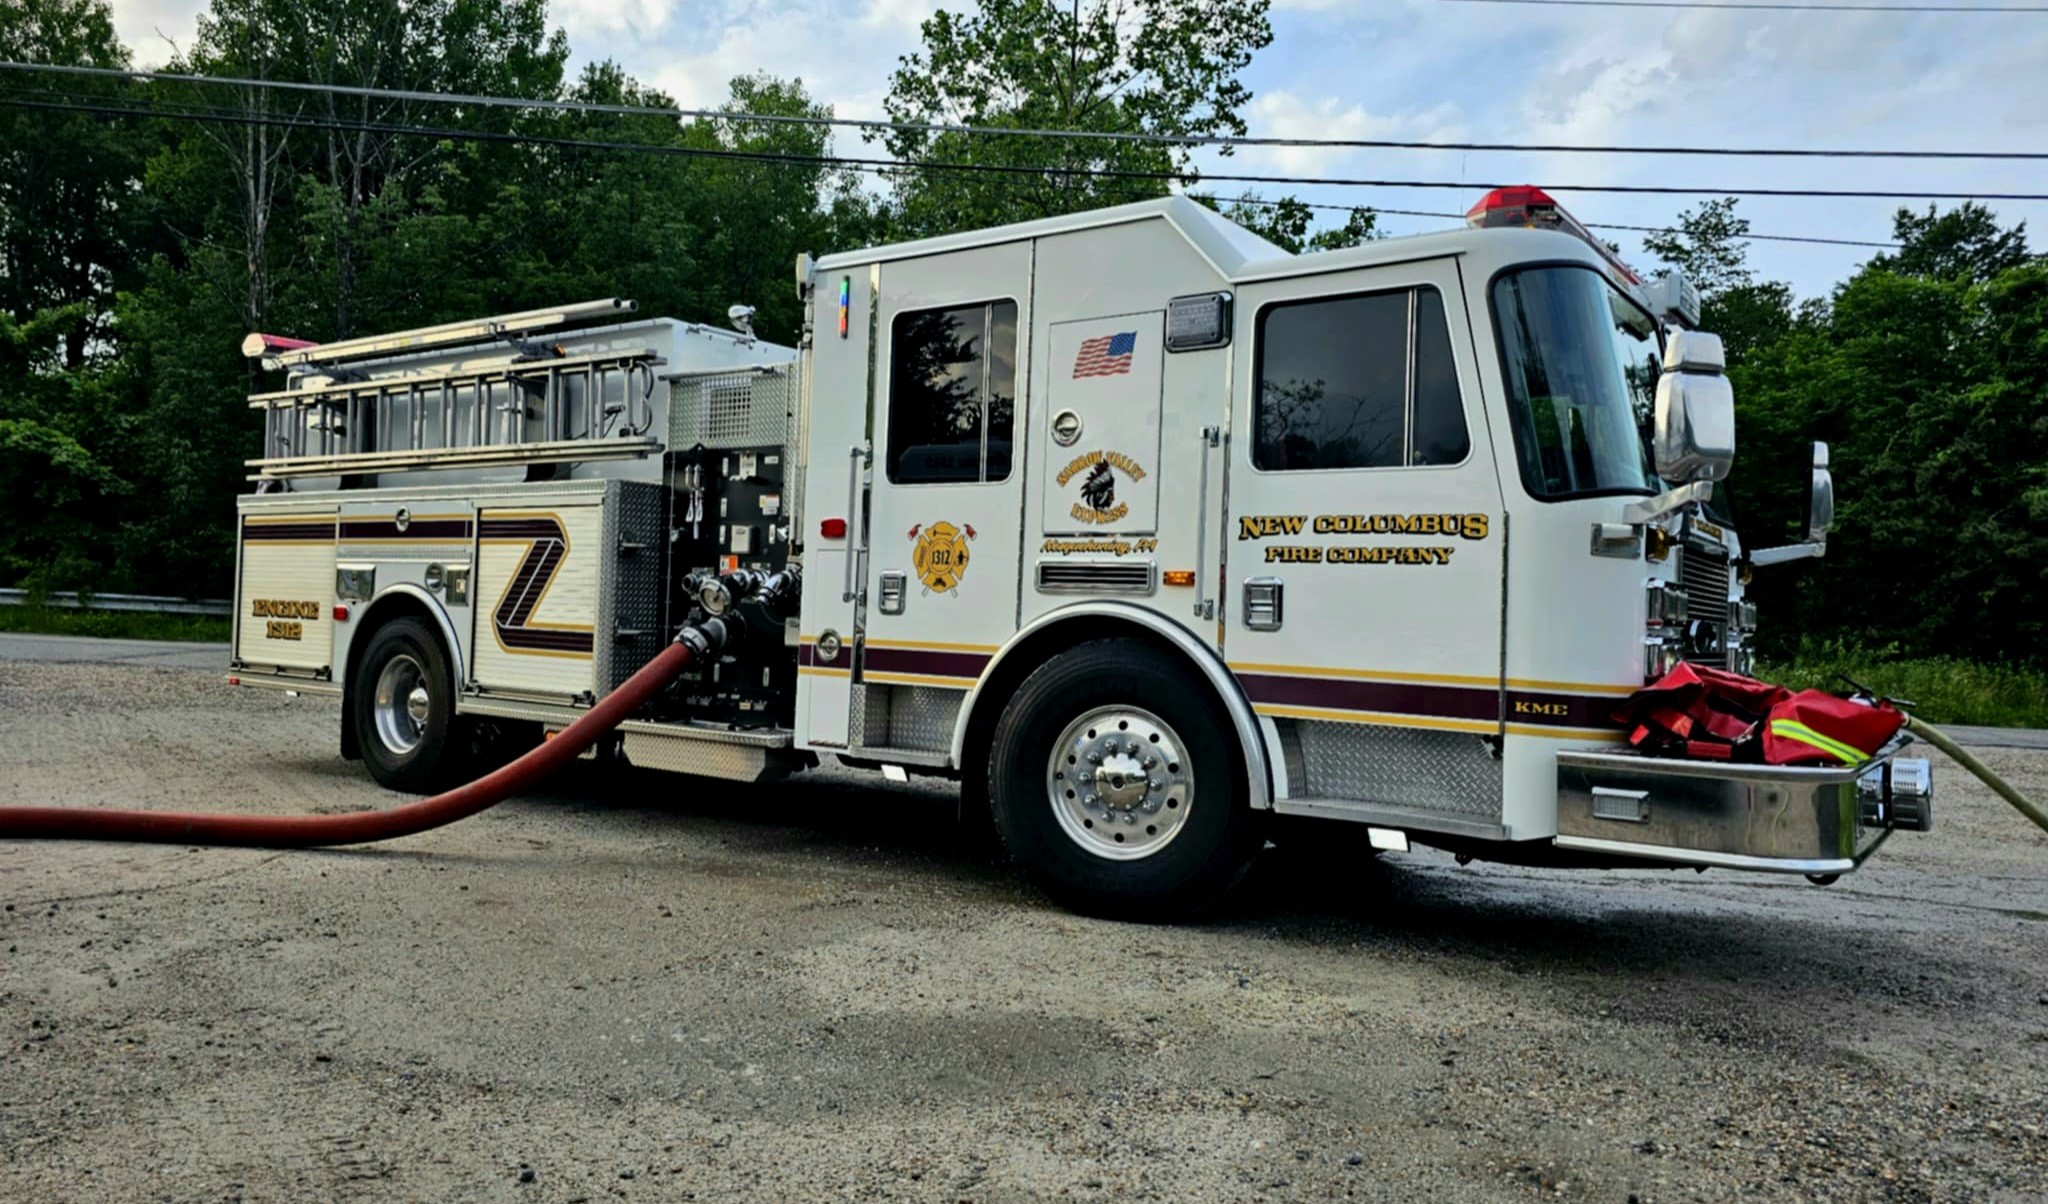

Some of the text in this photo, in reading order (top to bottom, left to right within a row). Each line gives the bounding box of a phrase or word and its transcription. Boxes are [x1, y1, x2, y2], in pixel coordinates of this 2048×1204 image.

[1106, 451, 1146, 482] VALLEY
[1070, 502, 1129, 525] EXPRESS
[1239, 513, 1489, 541] NEW COLUMBUS
[931, 549, 951, 565] 1312
[1265, 546, 1454, 565] FIRE COMPANY
[252, 599, 320, 620] ENGINE
[1514, 701, 1569, 716] KME
